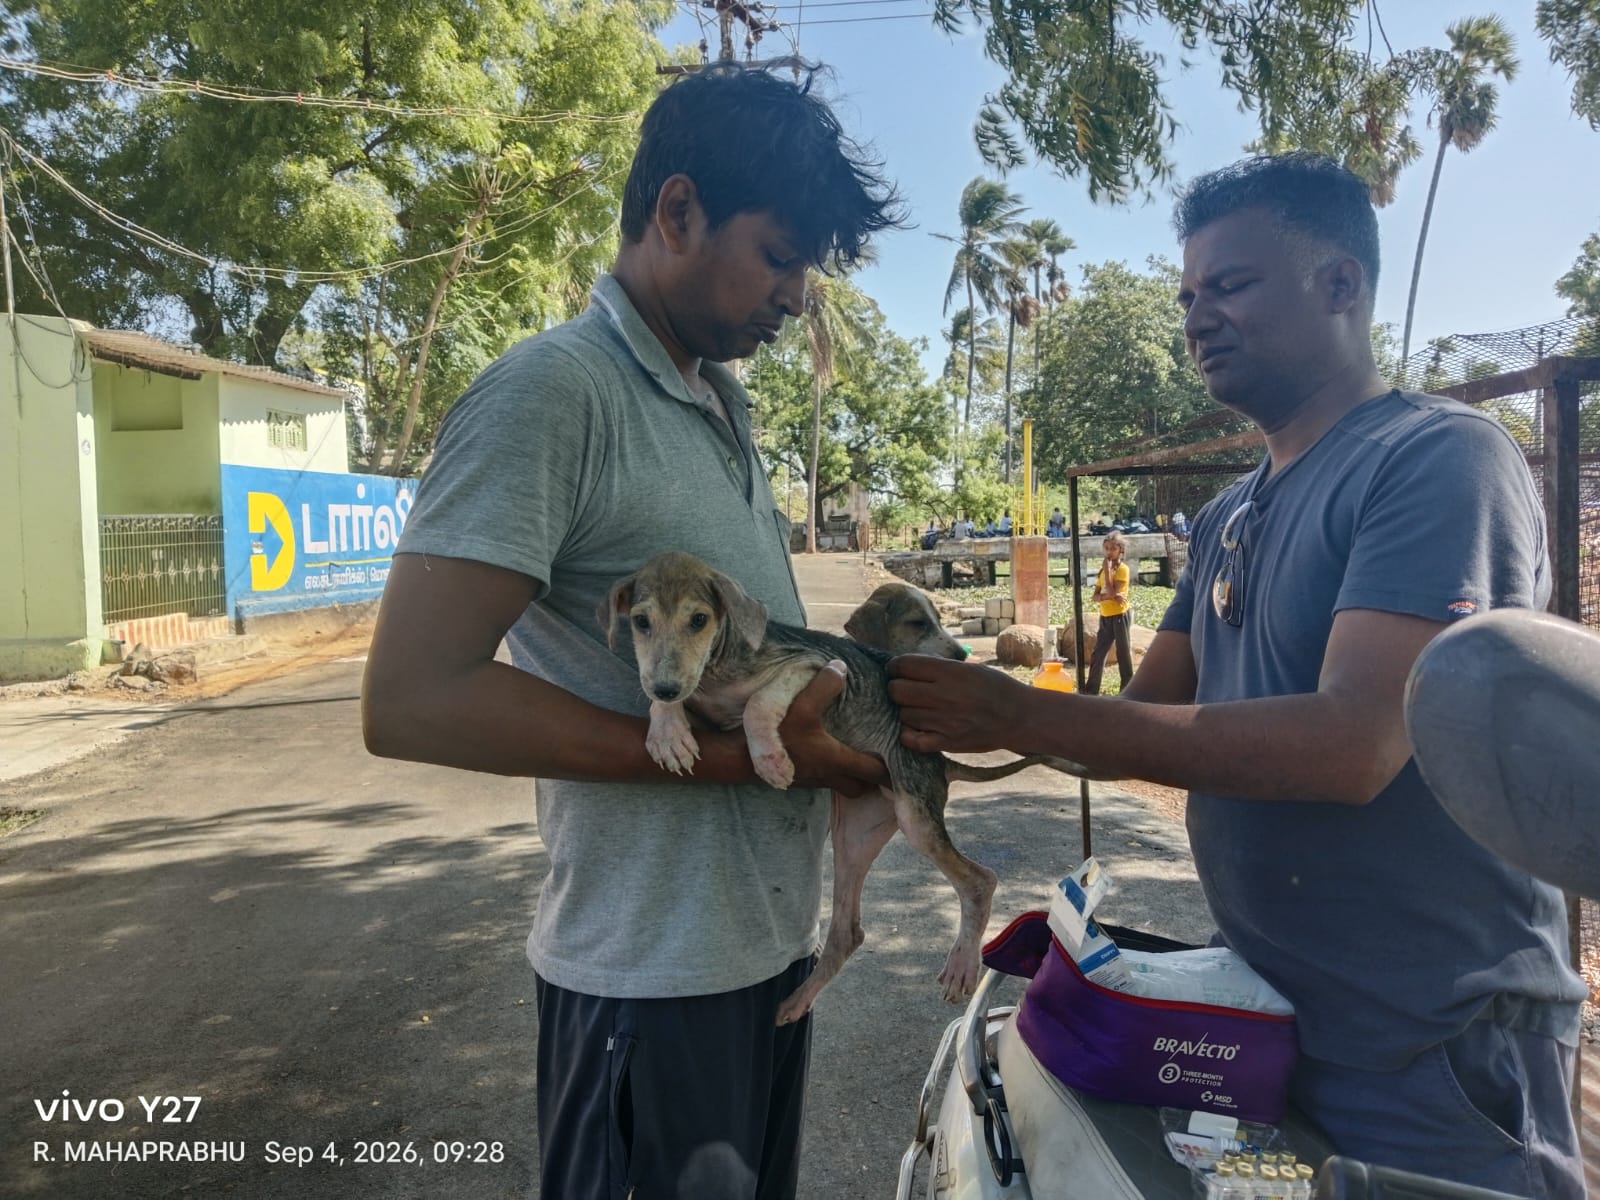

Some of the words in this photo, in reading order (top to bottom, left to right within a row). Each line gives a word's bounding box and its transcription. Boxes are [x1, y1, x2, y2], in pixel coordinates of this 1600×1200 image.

[1182, 1070, 1224, 1081] THREE-MONTH
[1181, 1077, 1222, 1087] PROTECTION
[1214, 1094, 1233, 1104] MSD
